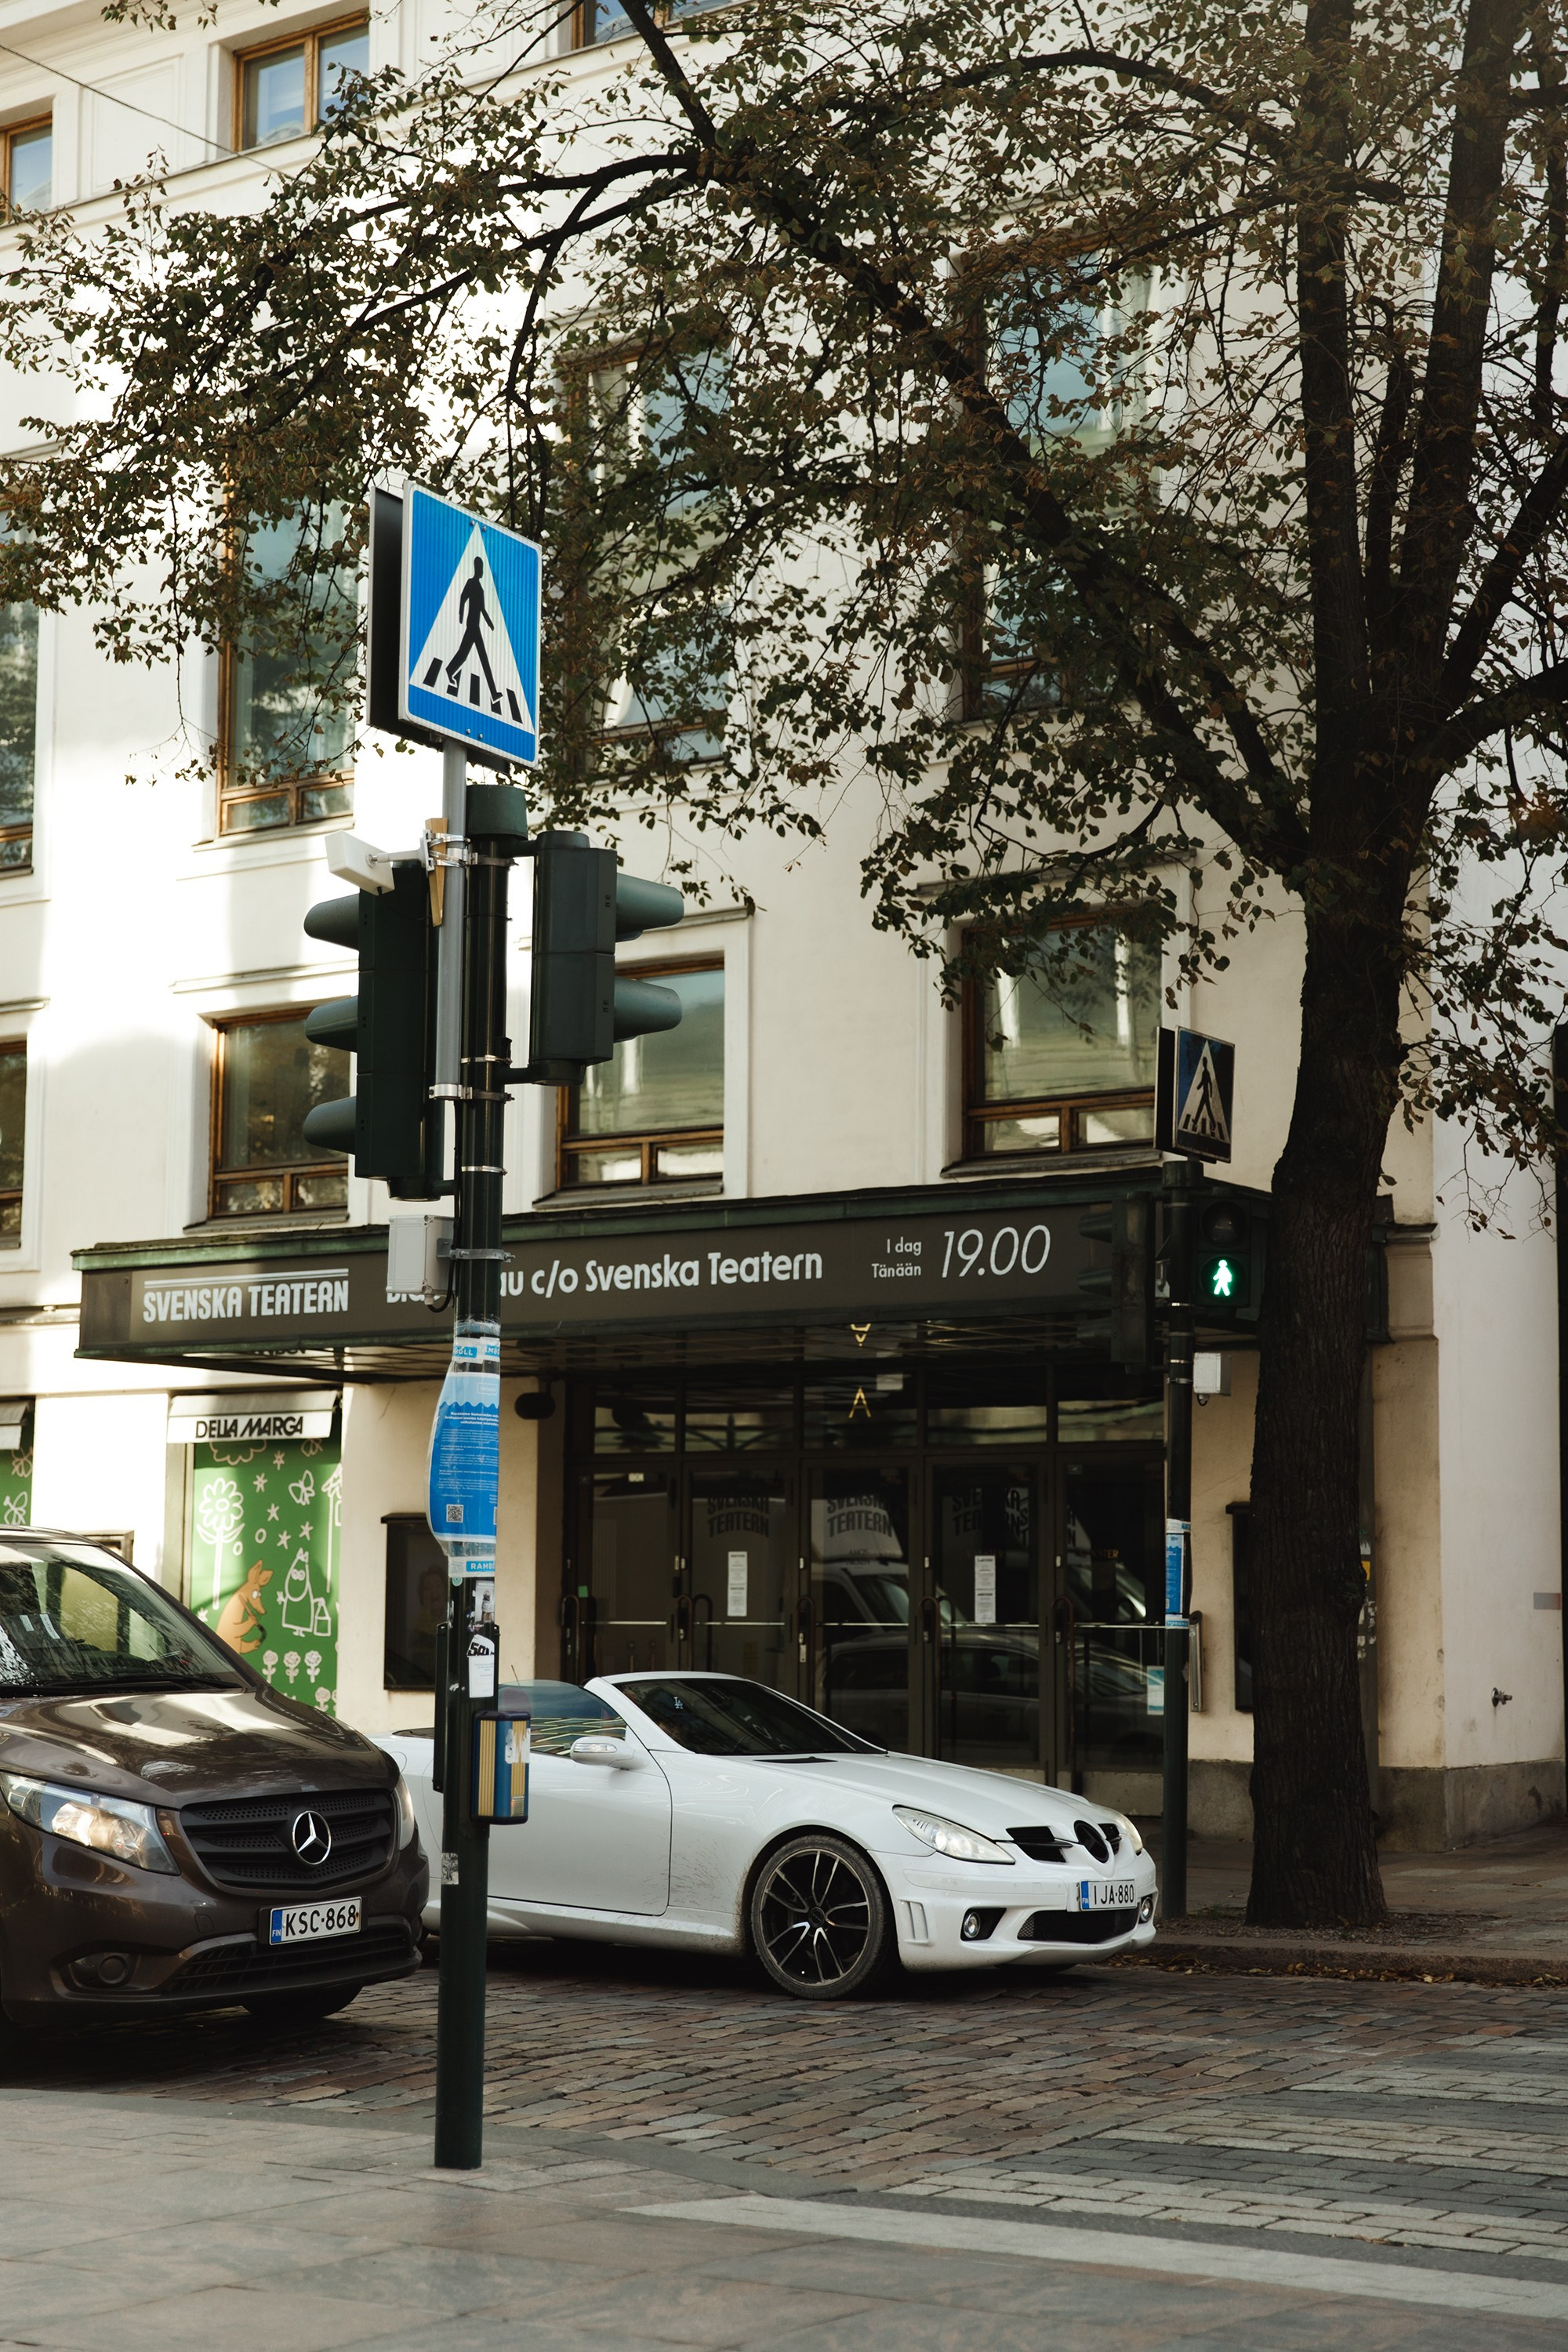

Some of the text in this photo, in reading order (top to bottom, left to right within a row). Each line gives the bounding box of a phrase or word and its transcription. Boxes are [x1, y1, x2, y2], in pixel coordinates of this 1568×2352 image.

[886, 1237, 922, 1257] I dag
[942, 1224, 1051, 1279] 19.00
[531, 1260, 579, 1298] c/o
[585, 1254, 700, 1293] Svenska
[708, 1250, 822, 1286] Teatern
[871, 1261, 922, 1279] Tänään
[143, 1286, 241, 1323] SVENSKA
[248, 1280, 349, 1317] TEATERN
[848, 1386, 872, 1419] A
[195, 1415, 303, 1439] DELLA MARGA
[827, 1494, 887, 1513] SVENSK
[707, 1512, 769, 1537] TEATERN
[827, 1510, 892, 1537] TEATERN
[271, 1929, 281, 1937] FIN
